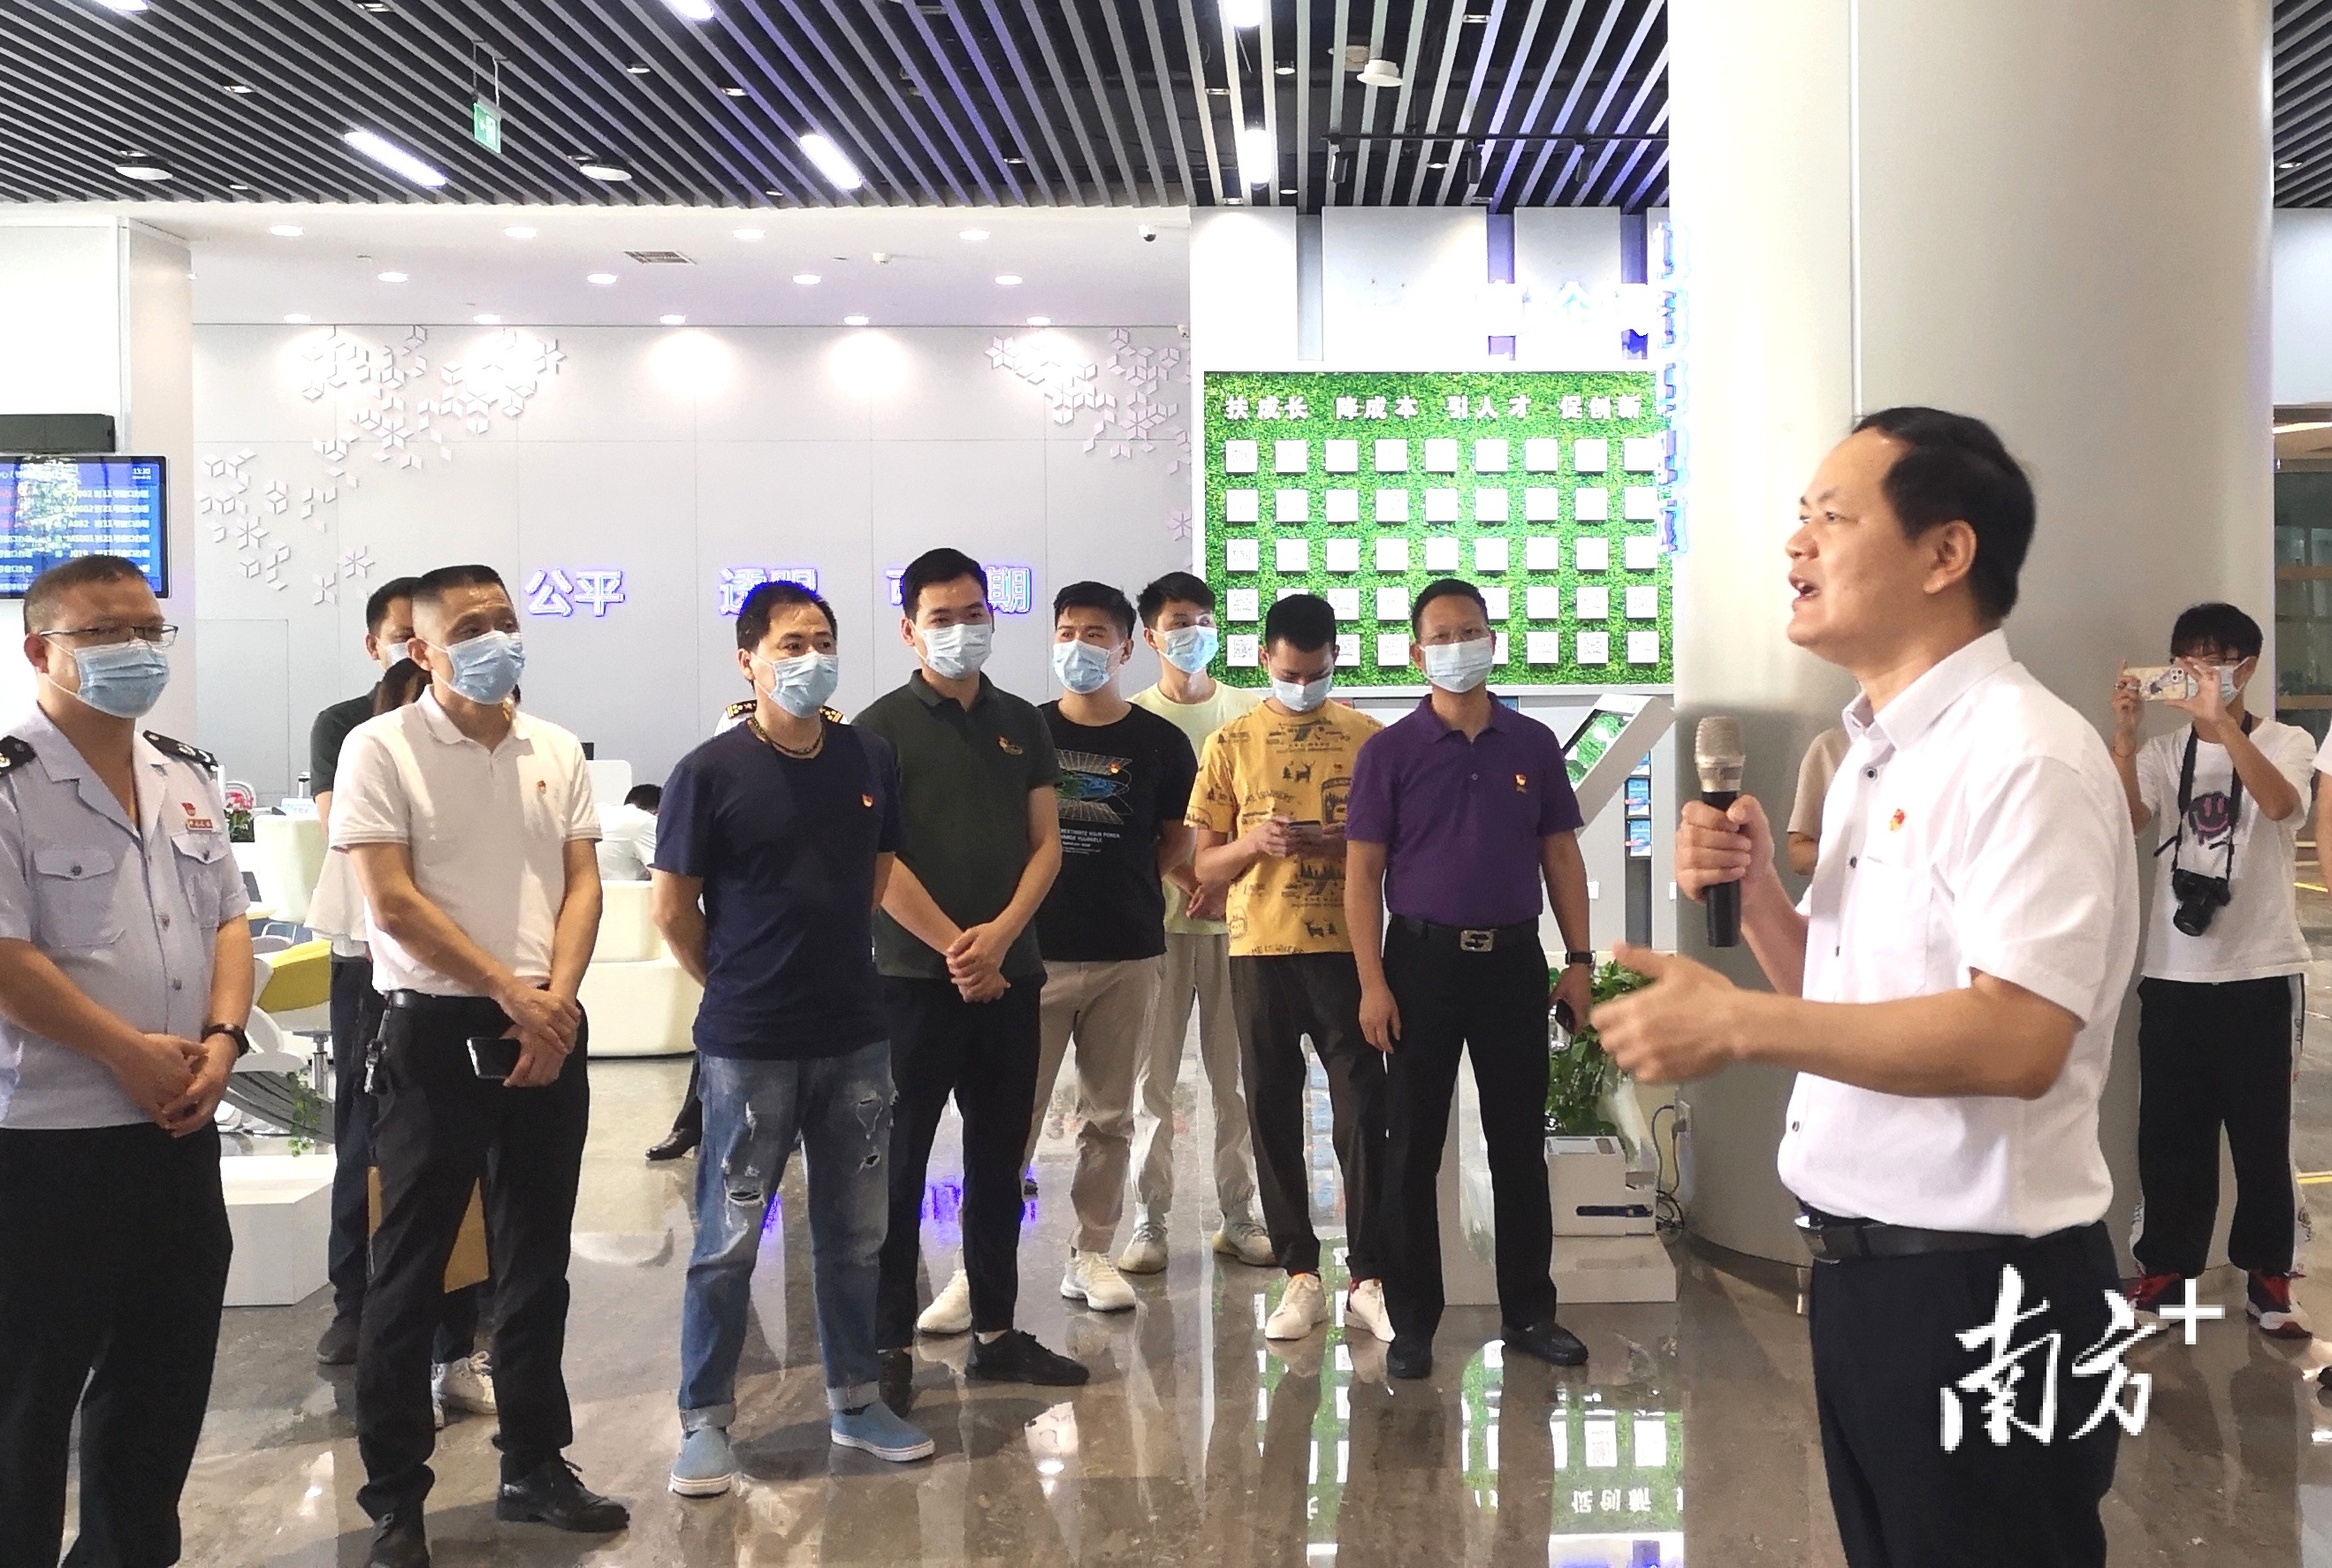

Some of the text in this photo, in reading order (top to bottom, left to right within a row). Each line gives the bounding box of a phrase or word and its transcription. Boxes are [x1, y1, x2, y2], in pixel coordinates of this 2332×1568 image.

[1225, 394, 1642, 420] 扶成长 降成本 引人才 促创新
[524, 568, 625, 617] 公平
